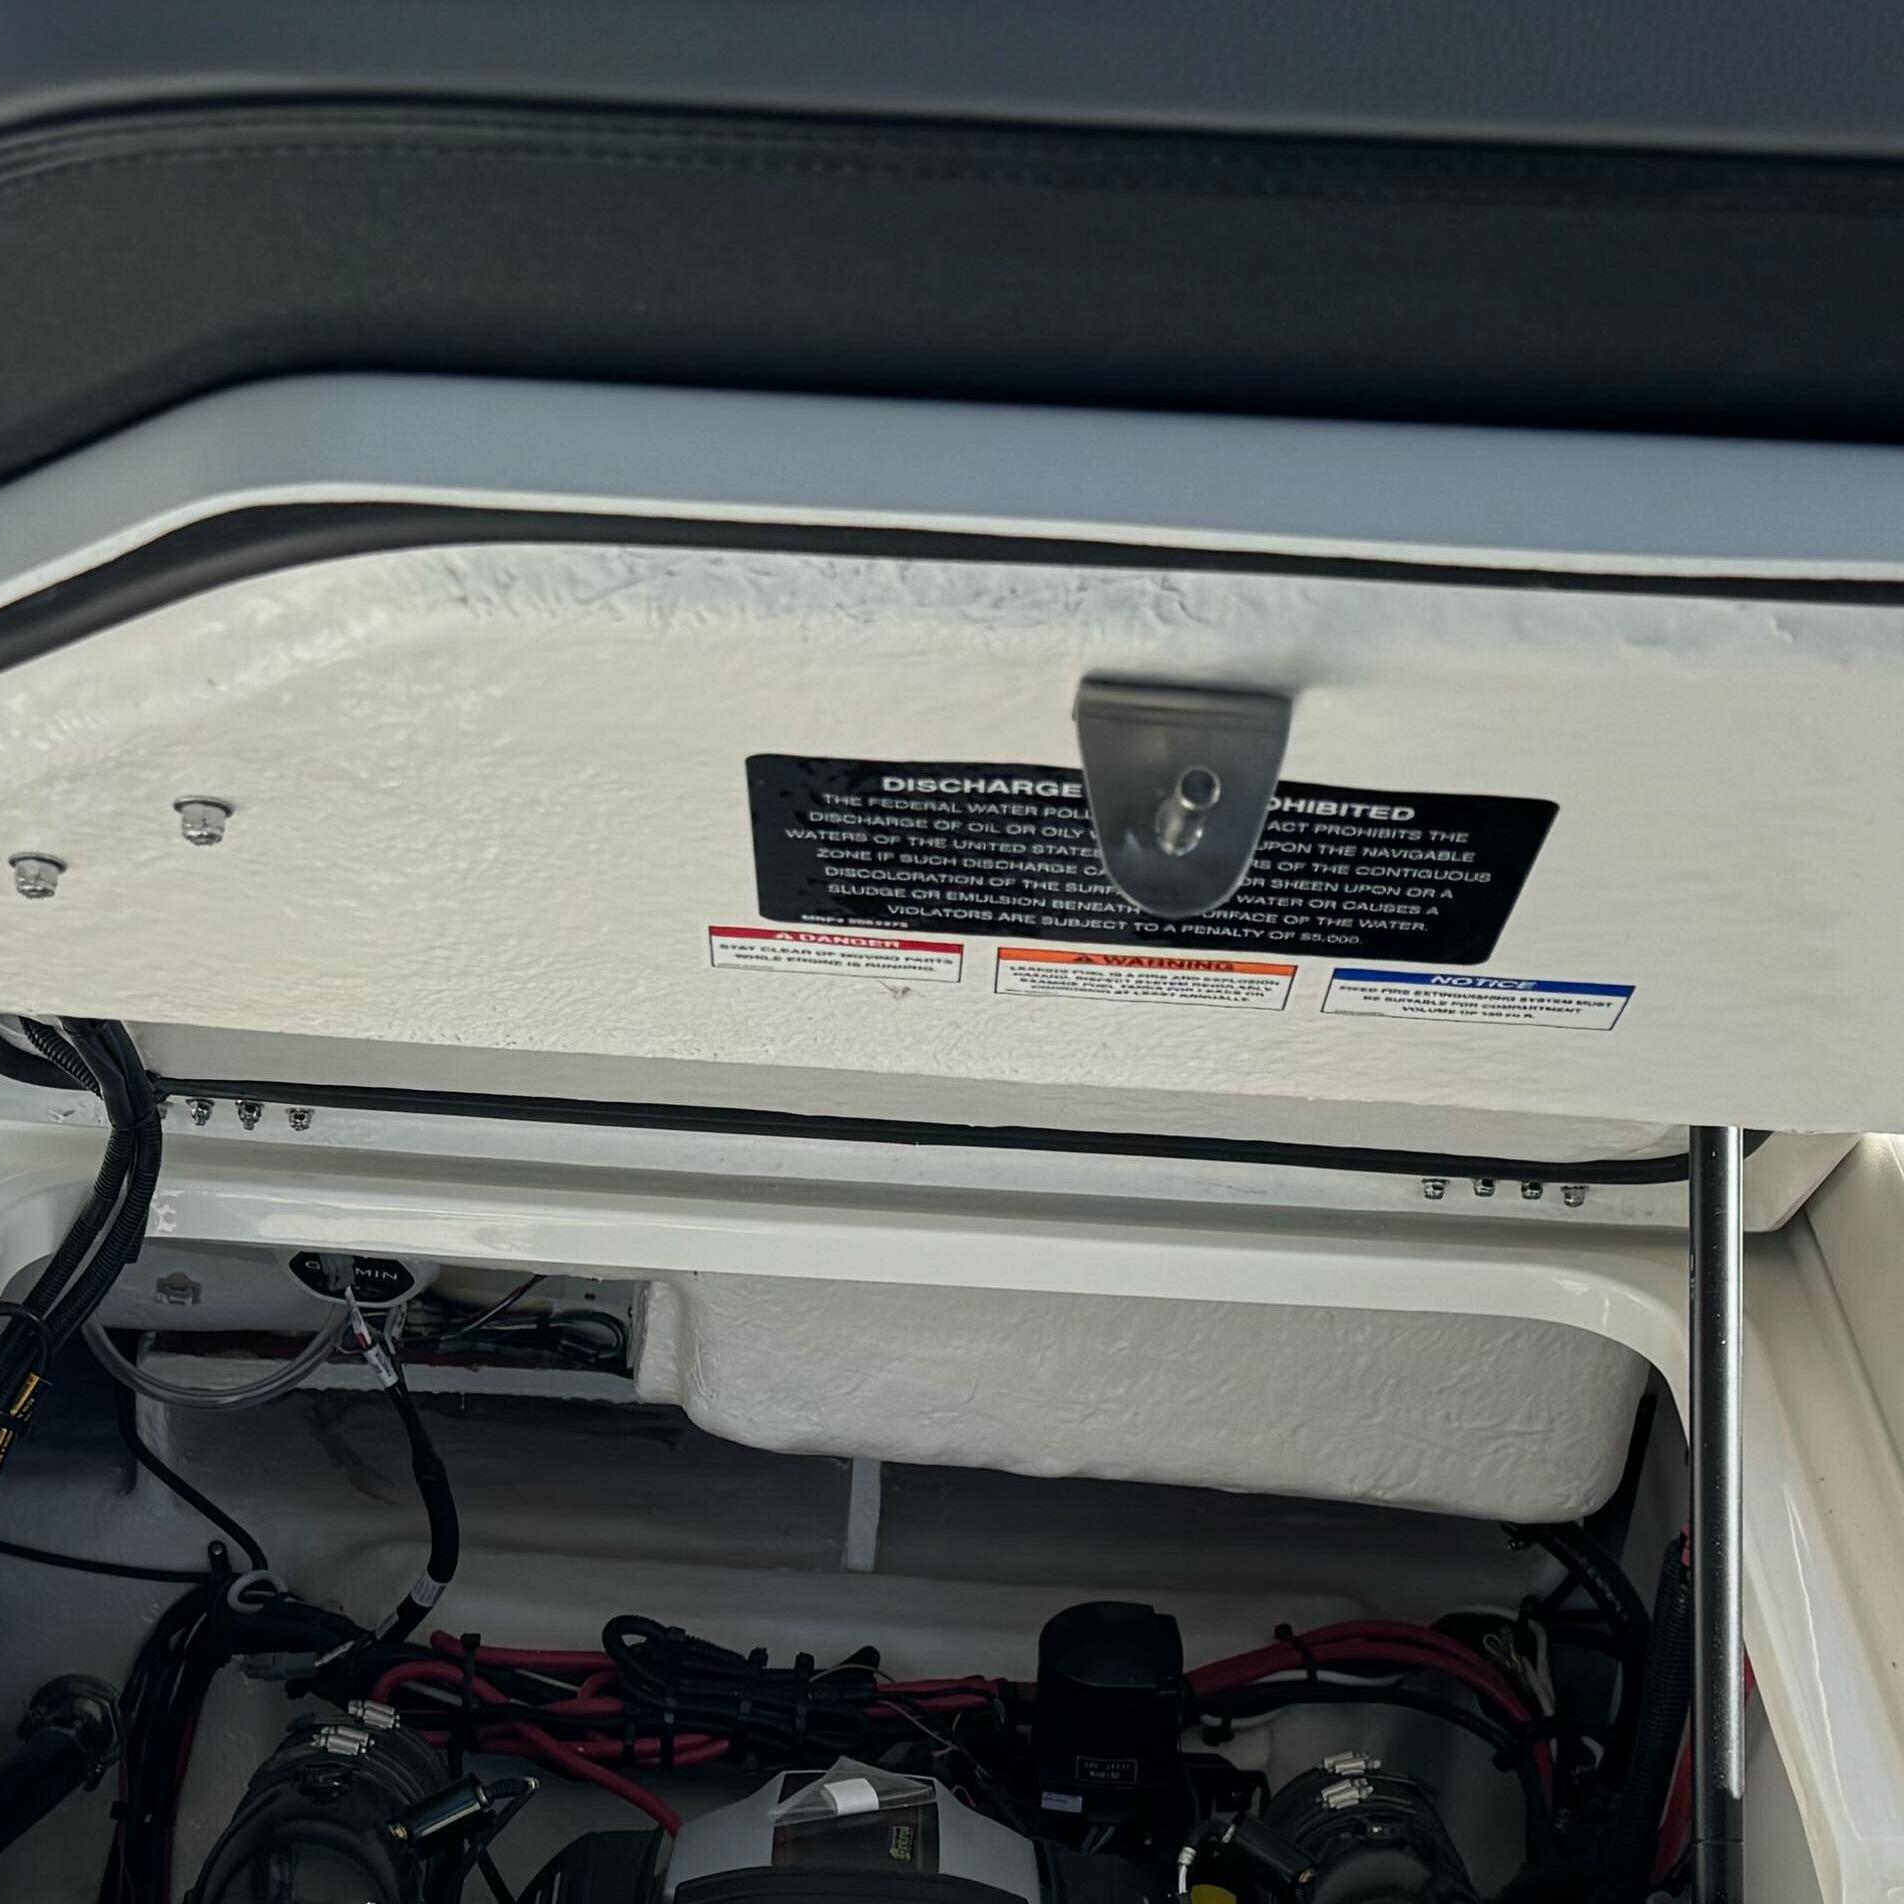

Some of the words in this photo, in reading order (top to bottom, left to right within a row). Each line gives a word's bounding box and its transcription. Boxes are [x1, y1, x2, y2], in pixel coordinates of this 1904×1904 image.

[824, 794, 861, 808] THE
[868, 796, 959, 812] FEDERAL
[966, 801, 1037, 816] WATER
[1314, 823, 1421, 841] PROHIBITS
[1429, 830, 1468, 844] THE
[882, 776, 1081, 798] DISCHARGE
[1269, 797, 1414, 821] OHIBITED
[808, 811, 927, 830] DISCHARGE
[933, 819, 961, 832] OF
[967, 821, 999, 834] OIL
[1005, 823, 1035, 837] OR
[1041, 826, 1083, 840] OILY
[1318, 844, 1356, 857] THE
[1362, 846, 1474, 863] NAVIGABLE
[816, 848, 871, 863] ZONE
[962, 856, 1077, 875] DISCHARGE
[1343, 882, 1400, 897] UPON
[1405, 885, 1435, 899] OR
[1440, 887, 1452, 900] A
[872, 834, 900, 847] OF
[907, 836, 946, 849] THE
[952, 838, 1026, 854] UNITED
[1277, 860, 1304, 873] OF
[1312, 862, 1349, 875] THE
[1355, 864, 1490, 883] CONTIGUOUS
[824, 866, 983, 887] DISCOLORATION
[988, 876, 1015, 889] OF
[1022, 878, 1059, 892] THE
[1237, 893, 1303, 909] WATER
[1308, 898, 1336, 911] OR
[1426, 905, 1438, 917] A
[911, 889, 940, 902] OR
[946, 891, 1046, 909] EMULSION
[1204, 909, 1278, 924] URFACE
[1282, 913, 1309, 926] OF
[1316, 915, 1352, 928] THE
[799, 934, 898, 948] DANGER
[887, 904, 992, 922] VIOLATORS
[997, 911, 1036, 925] ARE
[1040, 914, 1127, 931] SUBJECT
[1133, 920, 1158, 933] TO
[1163, 922, 1175, 934] A
[1181, 923, 1264, 940] PENALTY
[1269, 930, 1294, 942] OF
[1103, 955, 1233, 972] WARNING
[1430, 976, 1536, 990] NOTICE
[304, 1260, 398, 1281] GMIN
